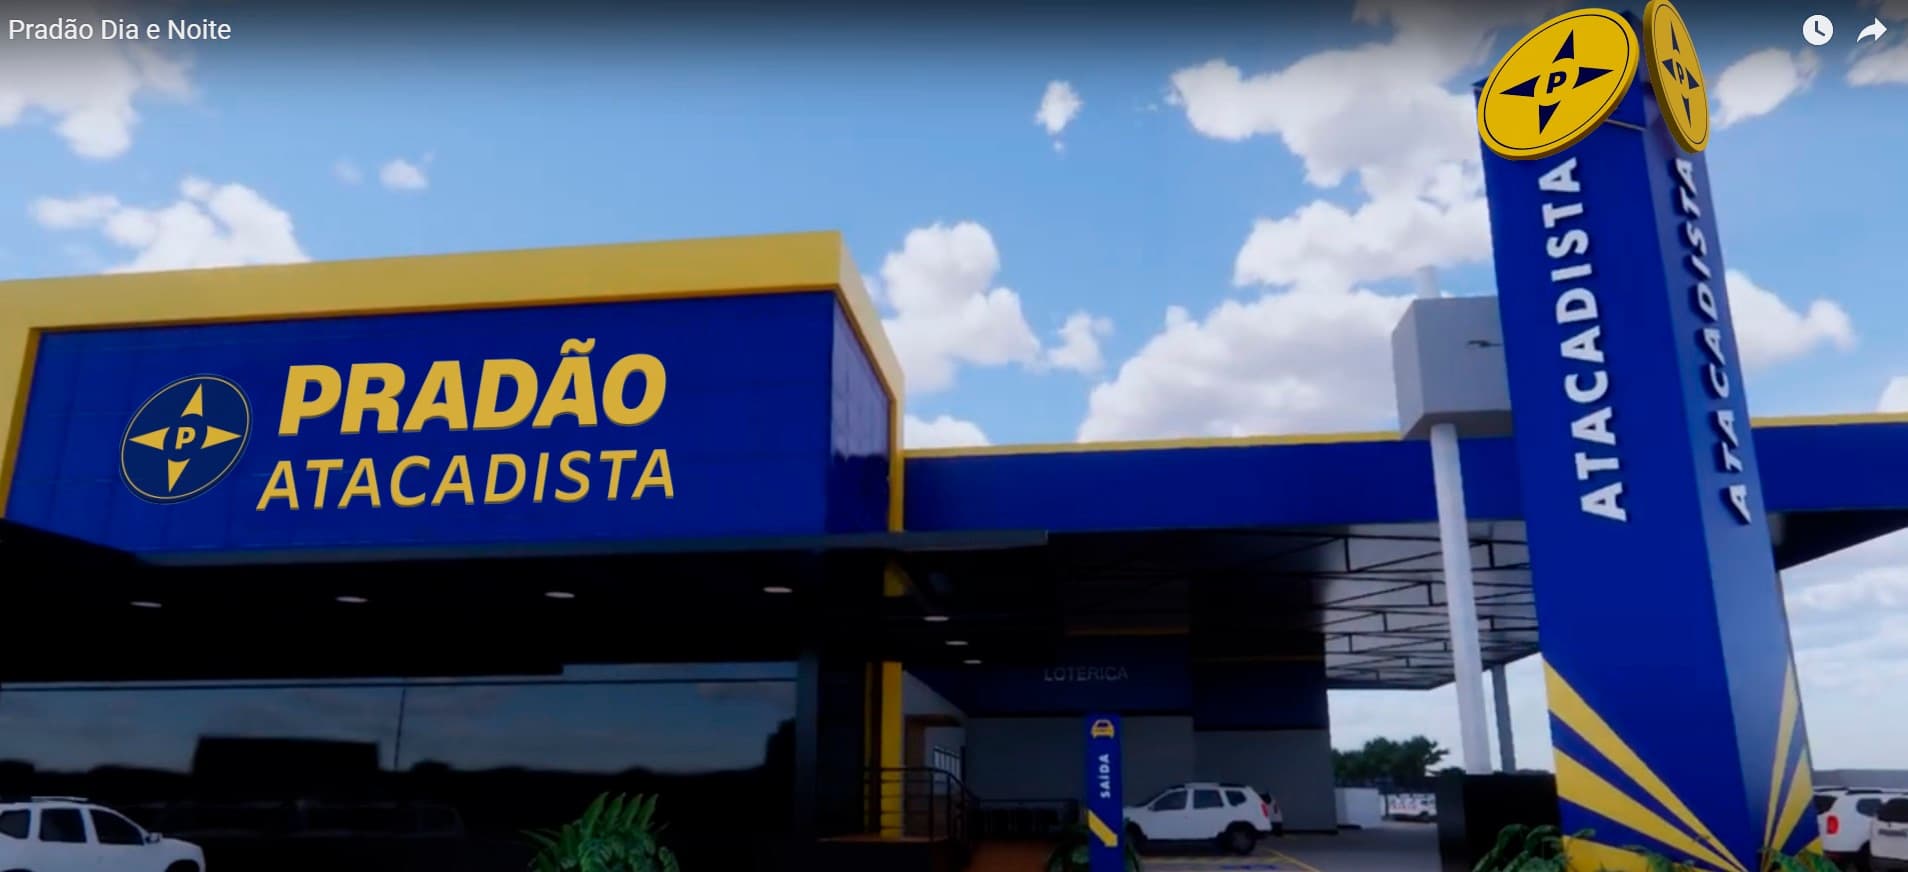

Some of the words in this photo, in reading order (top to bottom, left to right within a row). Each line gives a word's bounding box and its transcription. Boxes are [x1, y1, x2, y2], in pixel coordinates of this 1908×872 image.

[1546, 71, 1567, 94] P
[1675, 61, 1685, 85] P
[1538, 157, 1627, 522] ATACADISTA
[1674, 158, 1752, 524] ATACADISTA
[278, 338, 667, 437] PRADÃO
[175, 426, 196, 450] P
[256, 448, 675, 511] ATACADISTA
